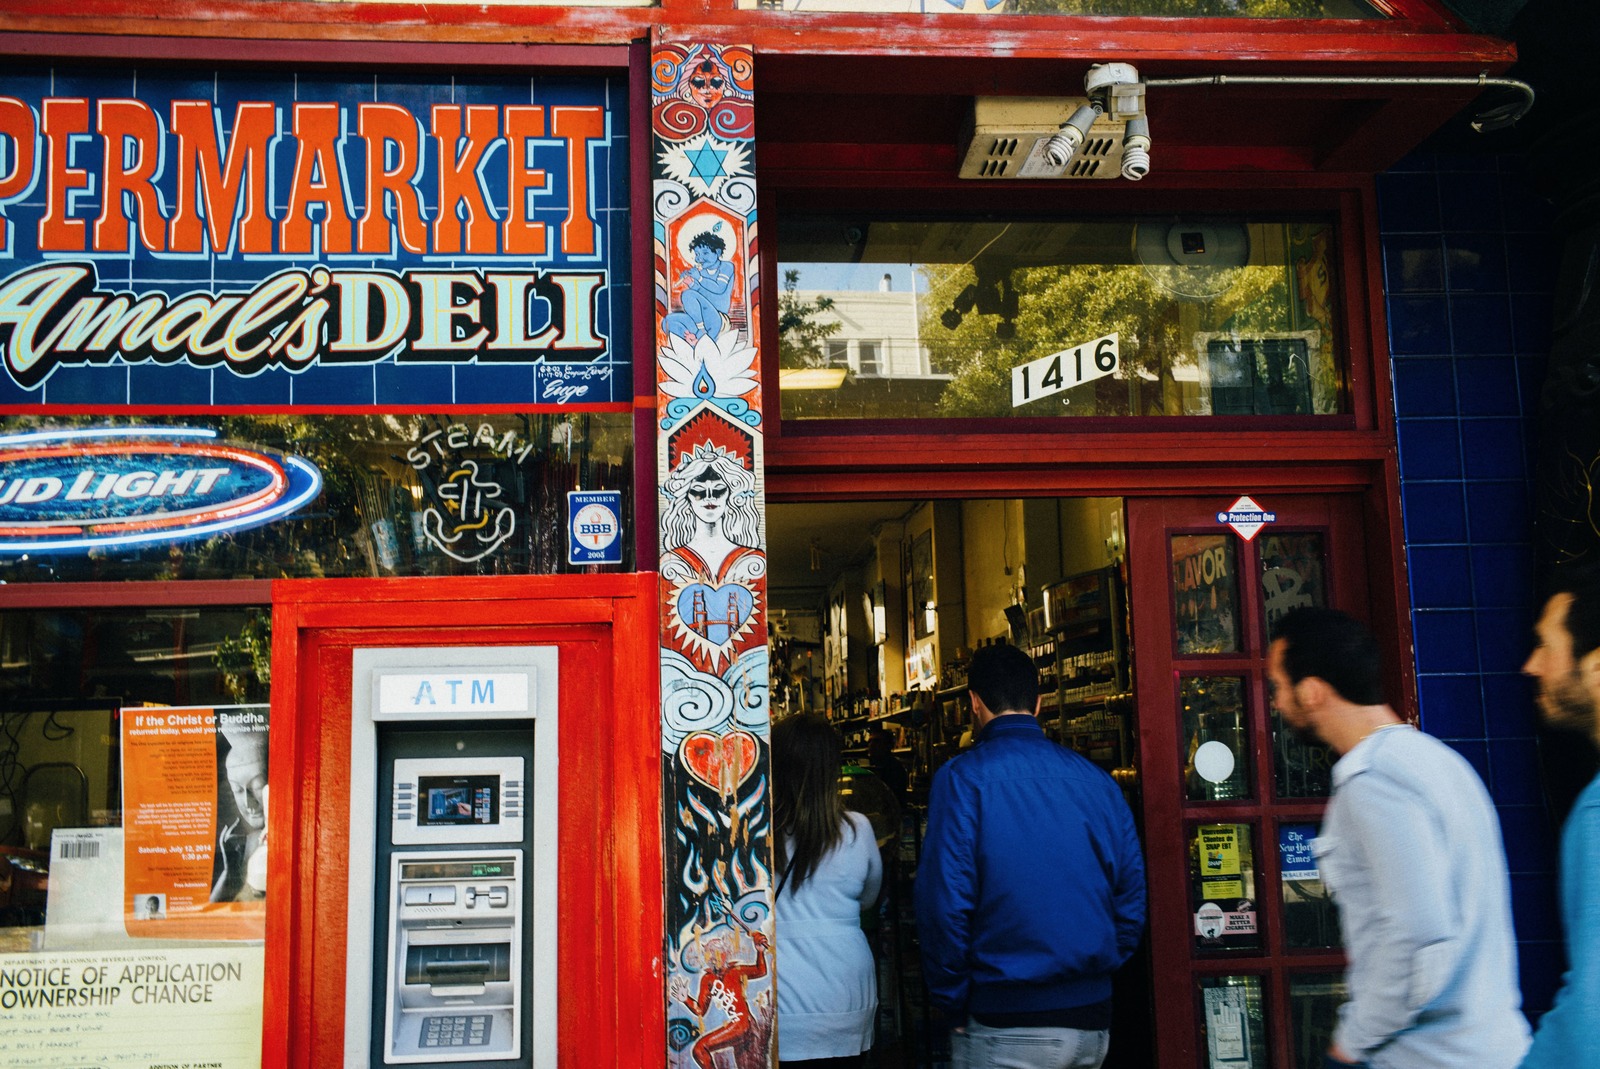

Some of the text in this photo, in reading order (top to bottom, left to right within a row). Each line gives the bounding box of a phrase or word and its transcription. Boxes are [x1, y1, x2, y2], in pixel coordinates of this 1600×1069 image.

[330, 273, 603, 352] DELI
[1021, 338, 1117, 400] 1416
[64, 468, 231, 501] LIGHT
[1228, 512, 1275, 522] Protection One
[580, 524, 611, 534] BBB
[413, 680, 495, 705] ATM
[135, 713, 265, 726] If the Christ or Buddha
[129, 728, 159, 736] returned
[160, 728, 181, 736] today,
[203, 727, 217, 735] you
[217, 726, 251, 734] recognize
[1287, 831, 1304, 841] The
[138, 846, 169, 854] Saturday,
[169, 845, 183, 854] July
[195, 844, 212, 852] 2014
[1286, 853, 1311, 864] Times
[0, 962, 242, 988] NOTICE OF APPLICATION
[1, 984, 213, 1010] OWNERSHIP CHANGE
